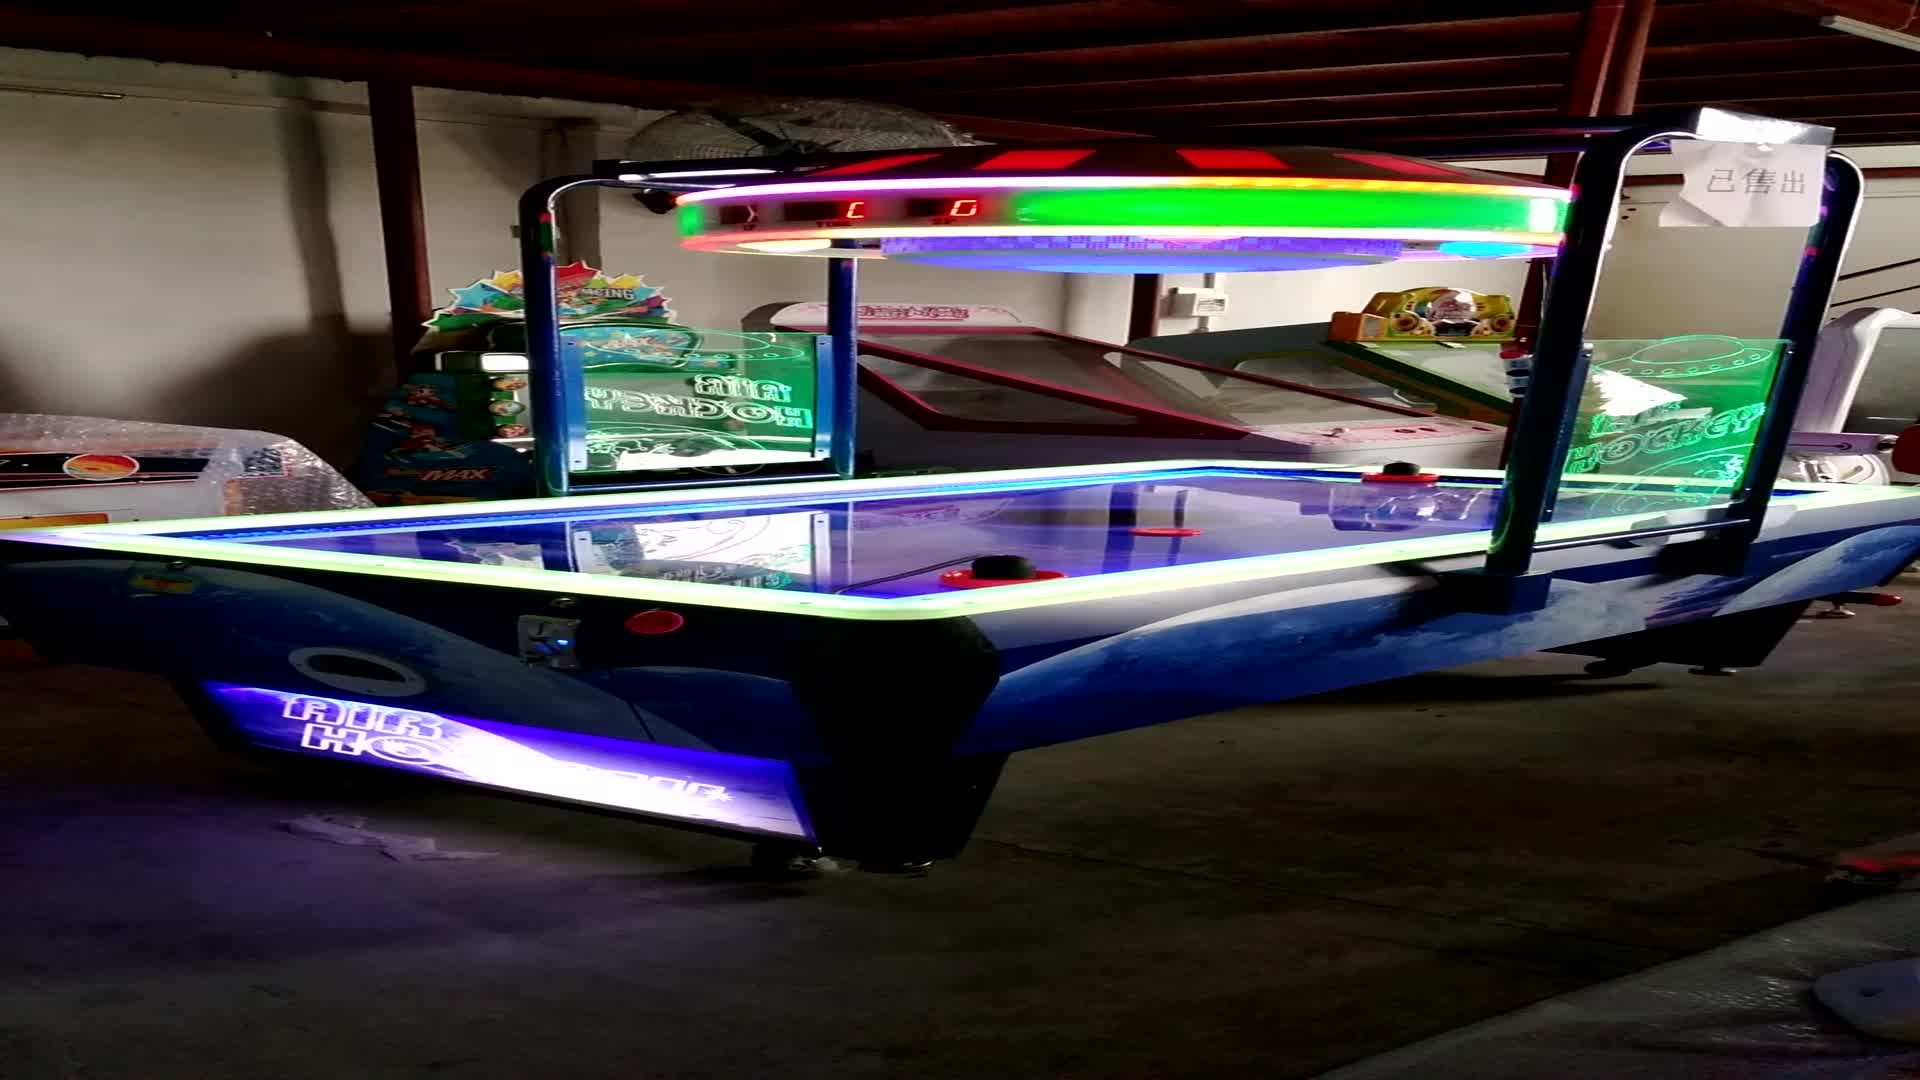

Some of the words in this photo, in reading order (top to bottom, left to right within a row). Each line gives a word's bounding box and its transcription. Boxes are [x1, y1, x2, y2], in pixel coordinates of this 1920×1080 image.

[1706, 168, 1805, 194] 已售出
[281, 696, 444, 739] AIR
